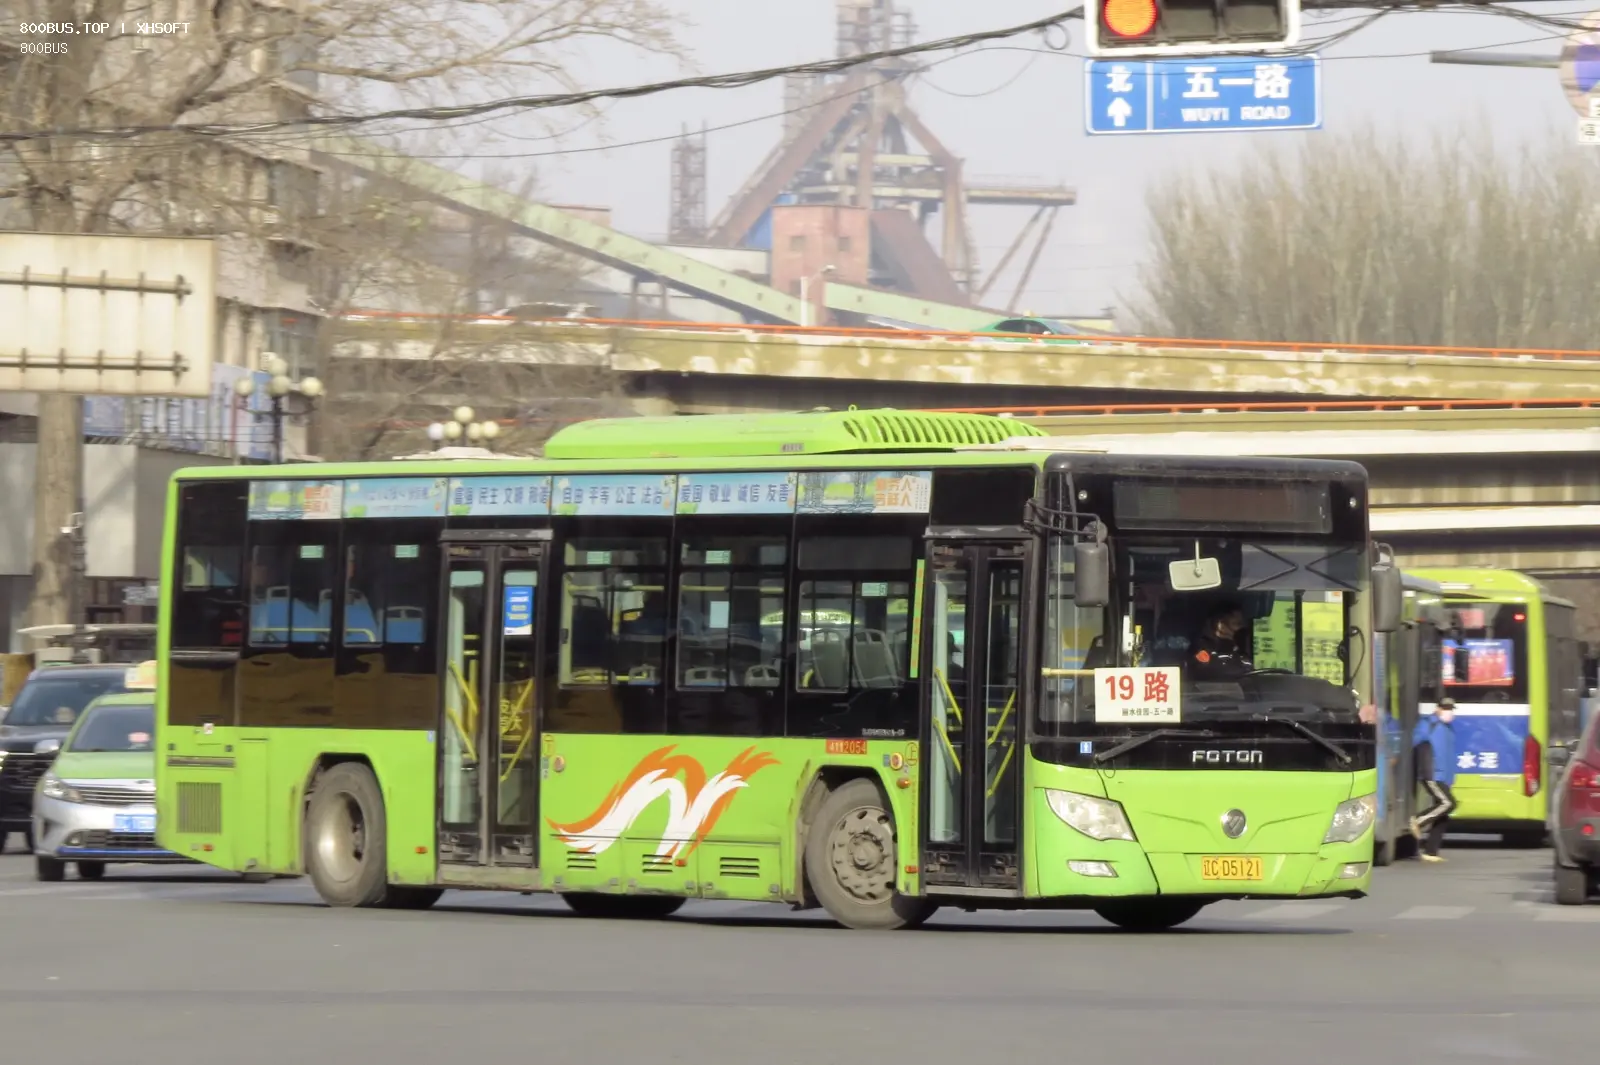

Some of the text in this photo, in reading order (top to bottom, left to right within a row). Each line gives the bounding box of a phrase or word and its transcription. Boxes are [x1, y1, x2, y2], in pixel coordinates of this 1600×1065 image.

[1106, 65, 1134, 93] 北
[1181, 64, 1292, 99] 五一路
[1180, 105, 1291, 122] WUYI ROAD
[479, 487, 498, 505] 民主
[589, 486, 610, 505] 平等
[615, 486, 637, 504] 公正
[680, 484, 703, 503] 爱国
[766, 483, 789, 502] 友善
[1105, 671, 1170, 703] 19 路
[1192, 750, 1263, 763] FOTON
[1456, 751, 1499, 769] 水泥
